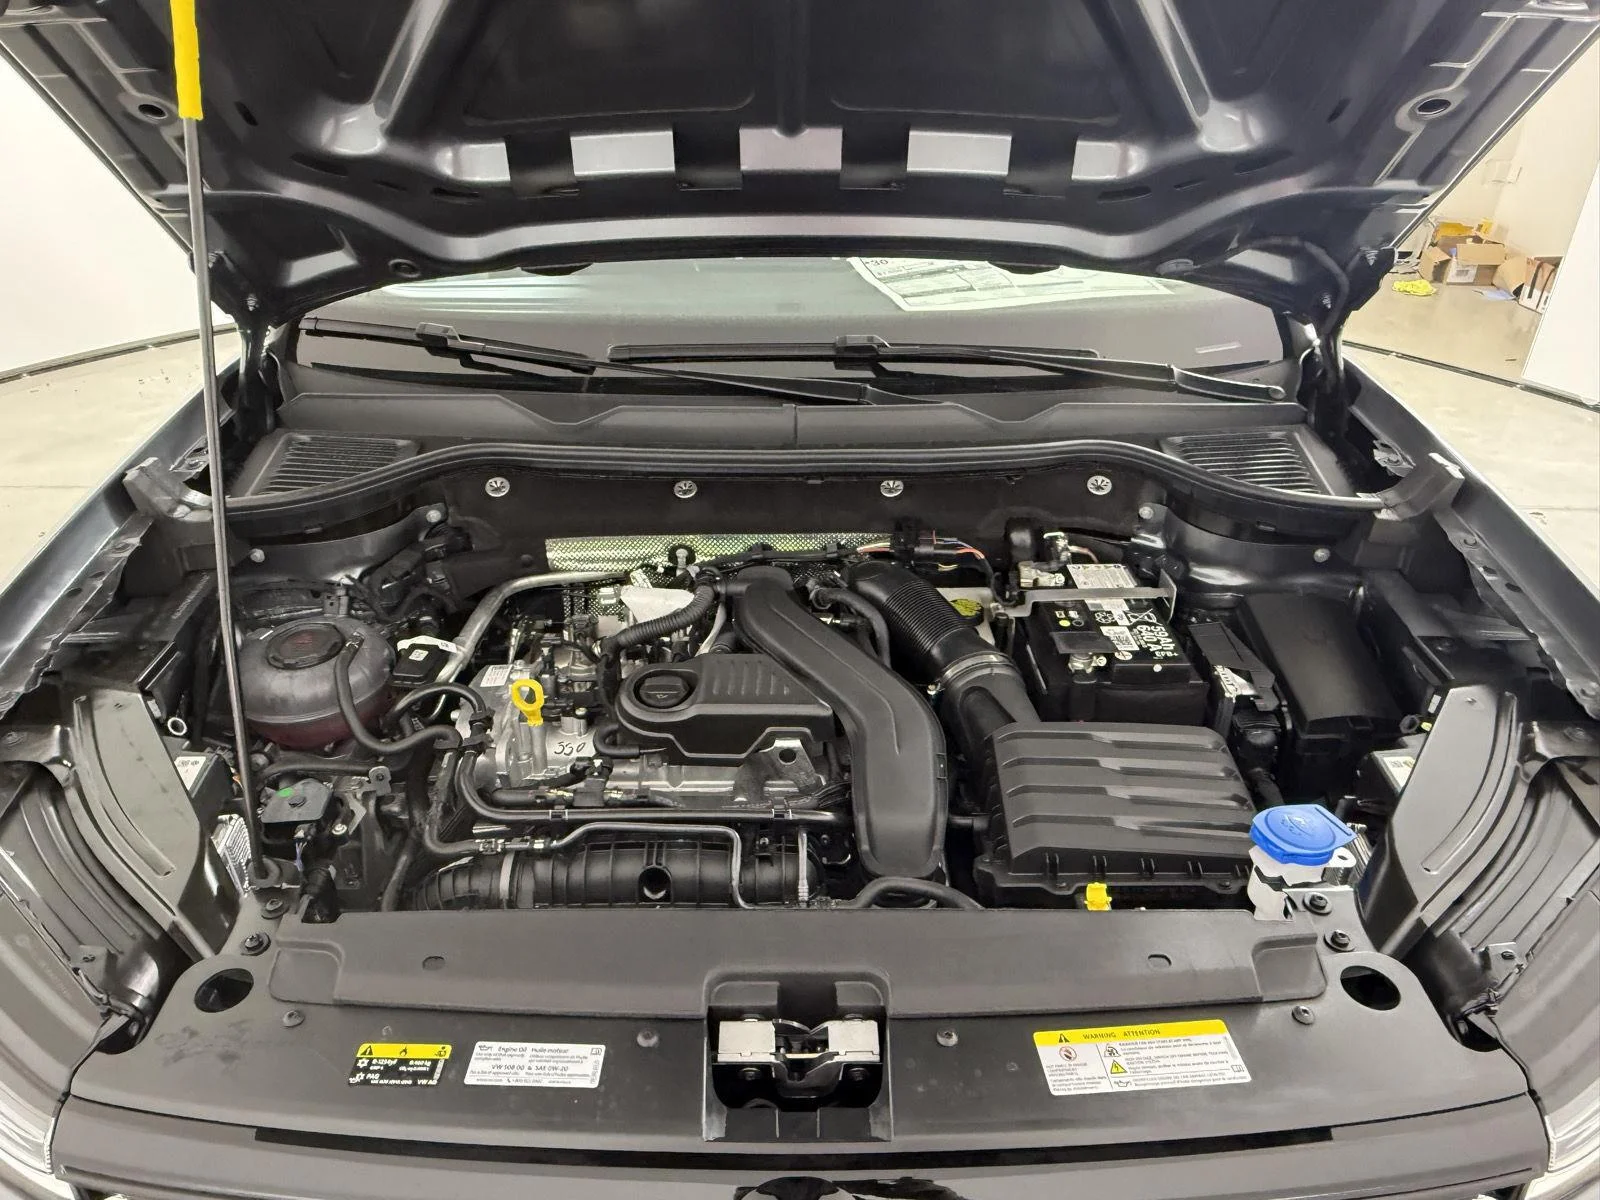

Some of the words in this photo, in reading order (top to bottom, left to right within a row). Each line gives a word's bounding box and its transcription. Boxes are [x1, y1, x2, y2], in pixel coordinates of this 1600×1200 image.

[1136, 624, 1158, 642] 640
[1151, 625, 1176, 650] 59Ah
[1083, 1032, 1117, 1040] WARNING
[1123, 1029, 1161, 1037] ATTENTION
